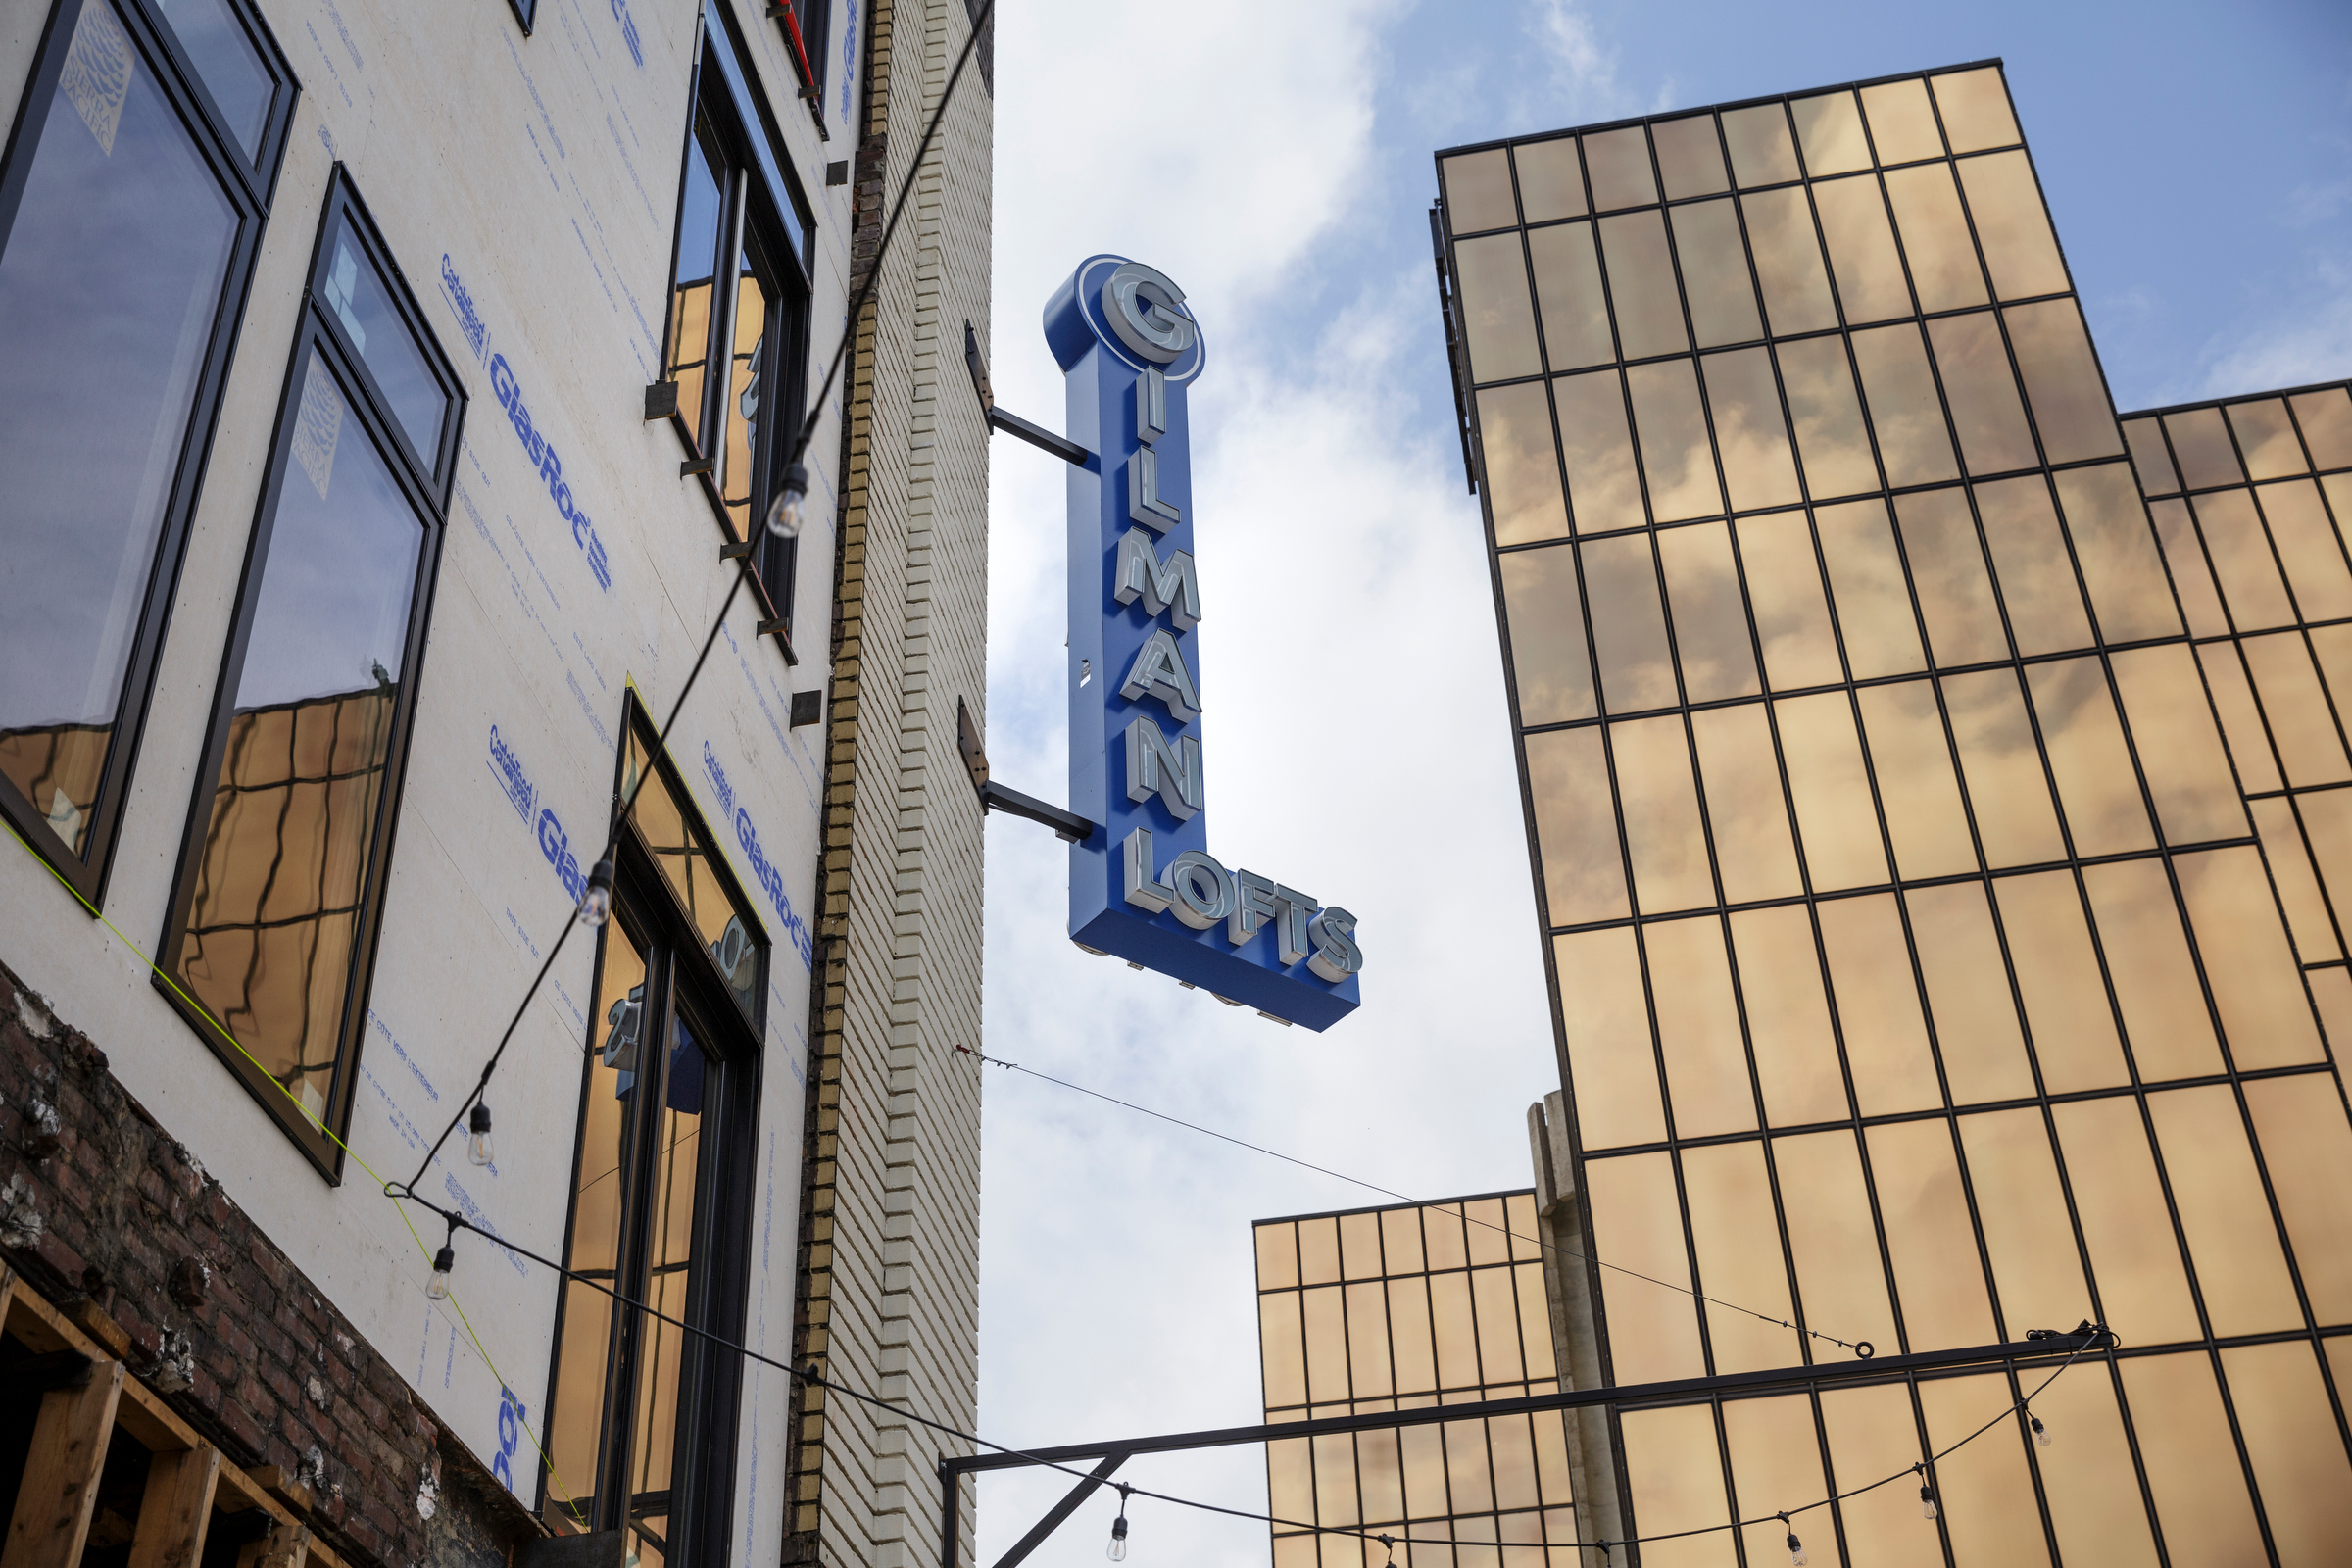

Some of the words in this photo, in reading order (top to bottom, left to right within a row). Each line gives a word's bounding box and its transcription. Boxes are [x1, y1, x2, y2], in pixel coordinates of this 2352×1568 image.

[62, 64, 112, 152] PACIFIC
[67, 55, 111, 132] SIERRA
[1101, 261, 1202, 823] GILMAN
[1123, 827, 1363, 983] LOFTS
